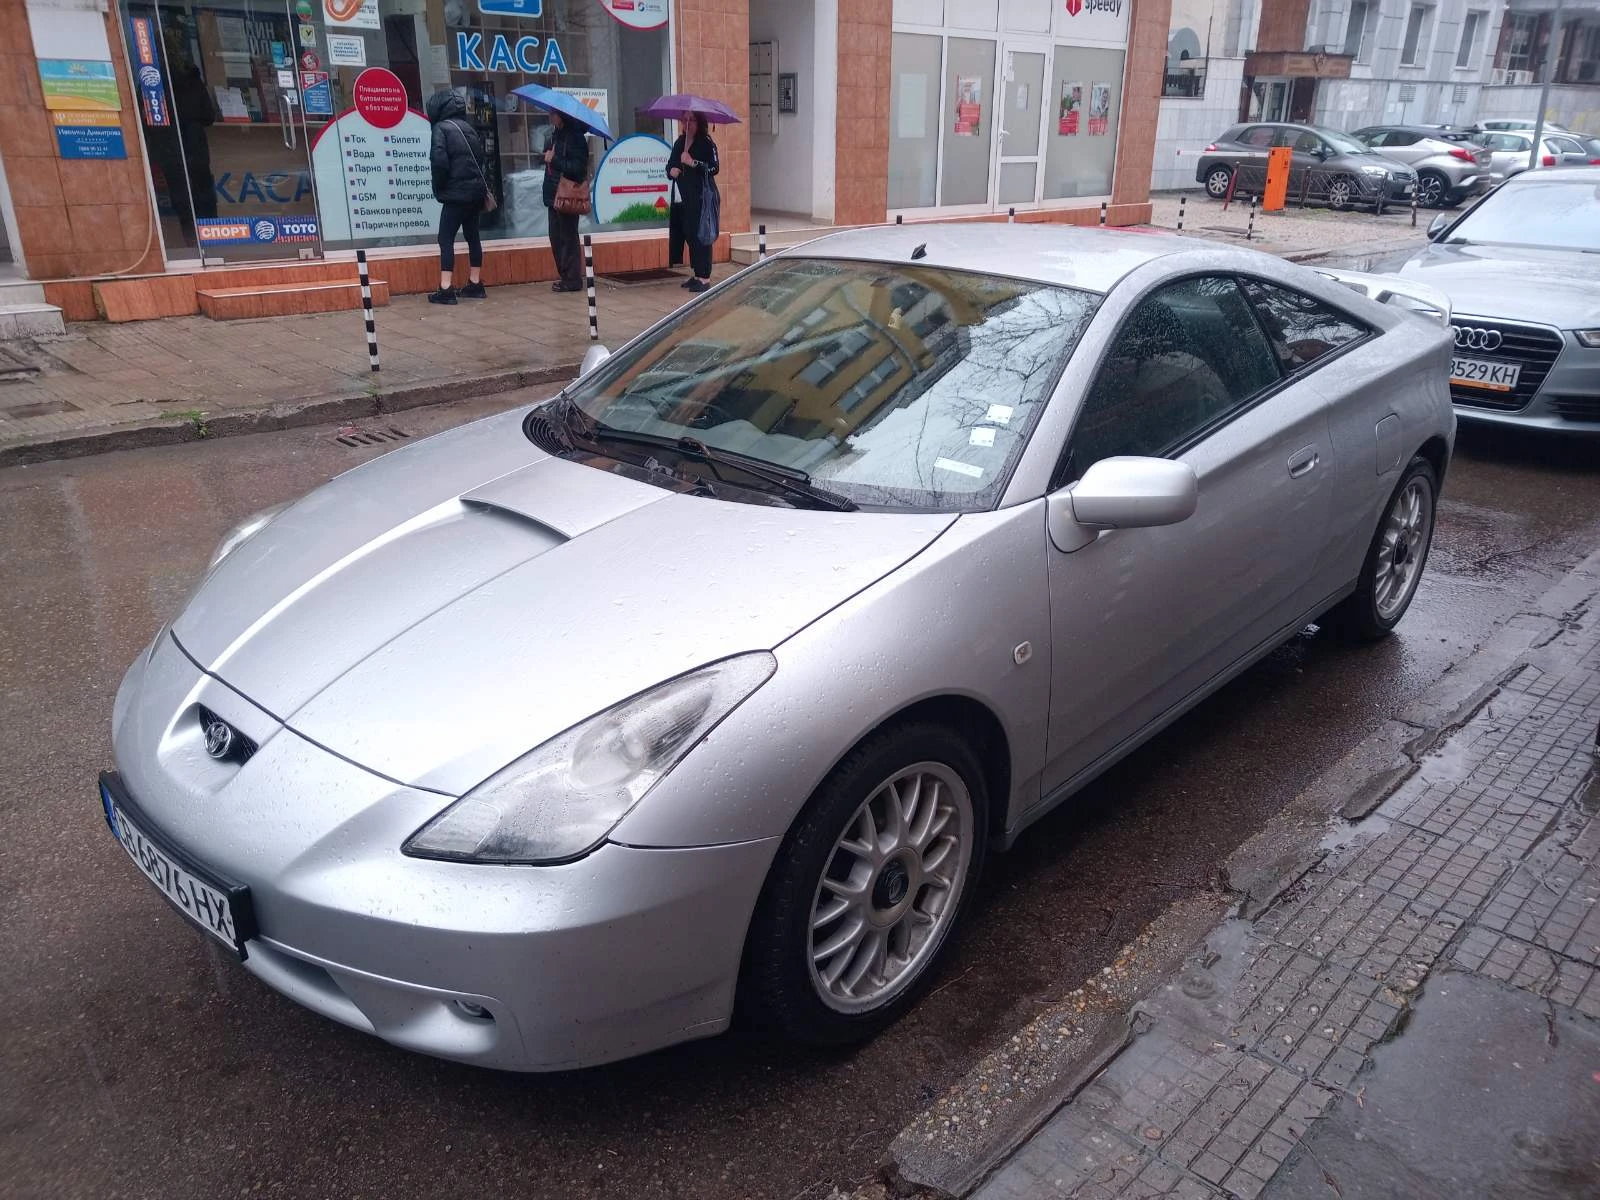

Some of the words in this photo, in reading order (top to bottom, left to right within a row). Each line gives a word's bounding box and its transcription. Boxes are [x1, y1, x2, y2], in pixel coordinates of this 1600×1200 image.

[1085, 0, 1122, 17] speedy
[136, 22, 150, 62] СПОРТ
[456, 32, 568, 74] КАСА
[150, 90, 161, 122] ТОТО
[351, 135, 366, 143] Ток
[391, 135, 421, 144] Билети
[353, 150, 375, 159] Вода
[392, 150, 427, 158] Винетки
[355, 164, 382, 174] Парно
[358, 193, 377, 201] GSM
[360, 207, 390, 216] Банков
[392, 206, 423, 216] превод
[283, 224, 317, 234] ТОТО
[361, 221, 398, 231] Паричен
[399, 219, 430, 230] превод
[201, 226, 248, 238] СПОРТ
[1490, 366, 1516, 384] KH
[138, 836, 190, 908] 6876
[189, 880, 235, 942] HX
